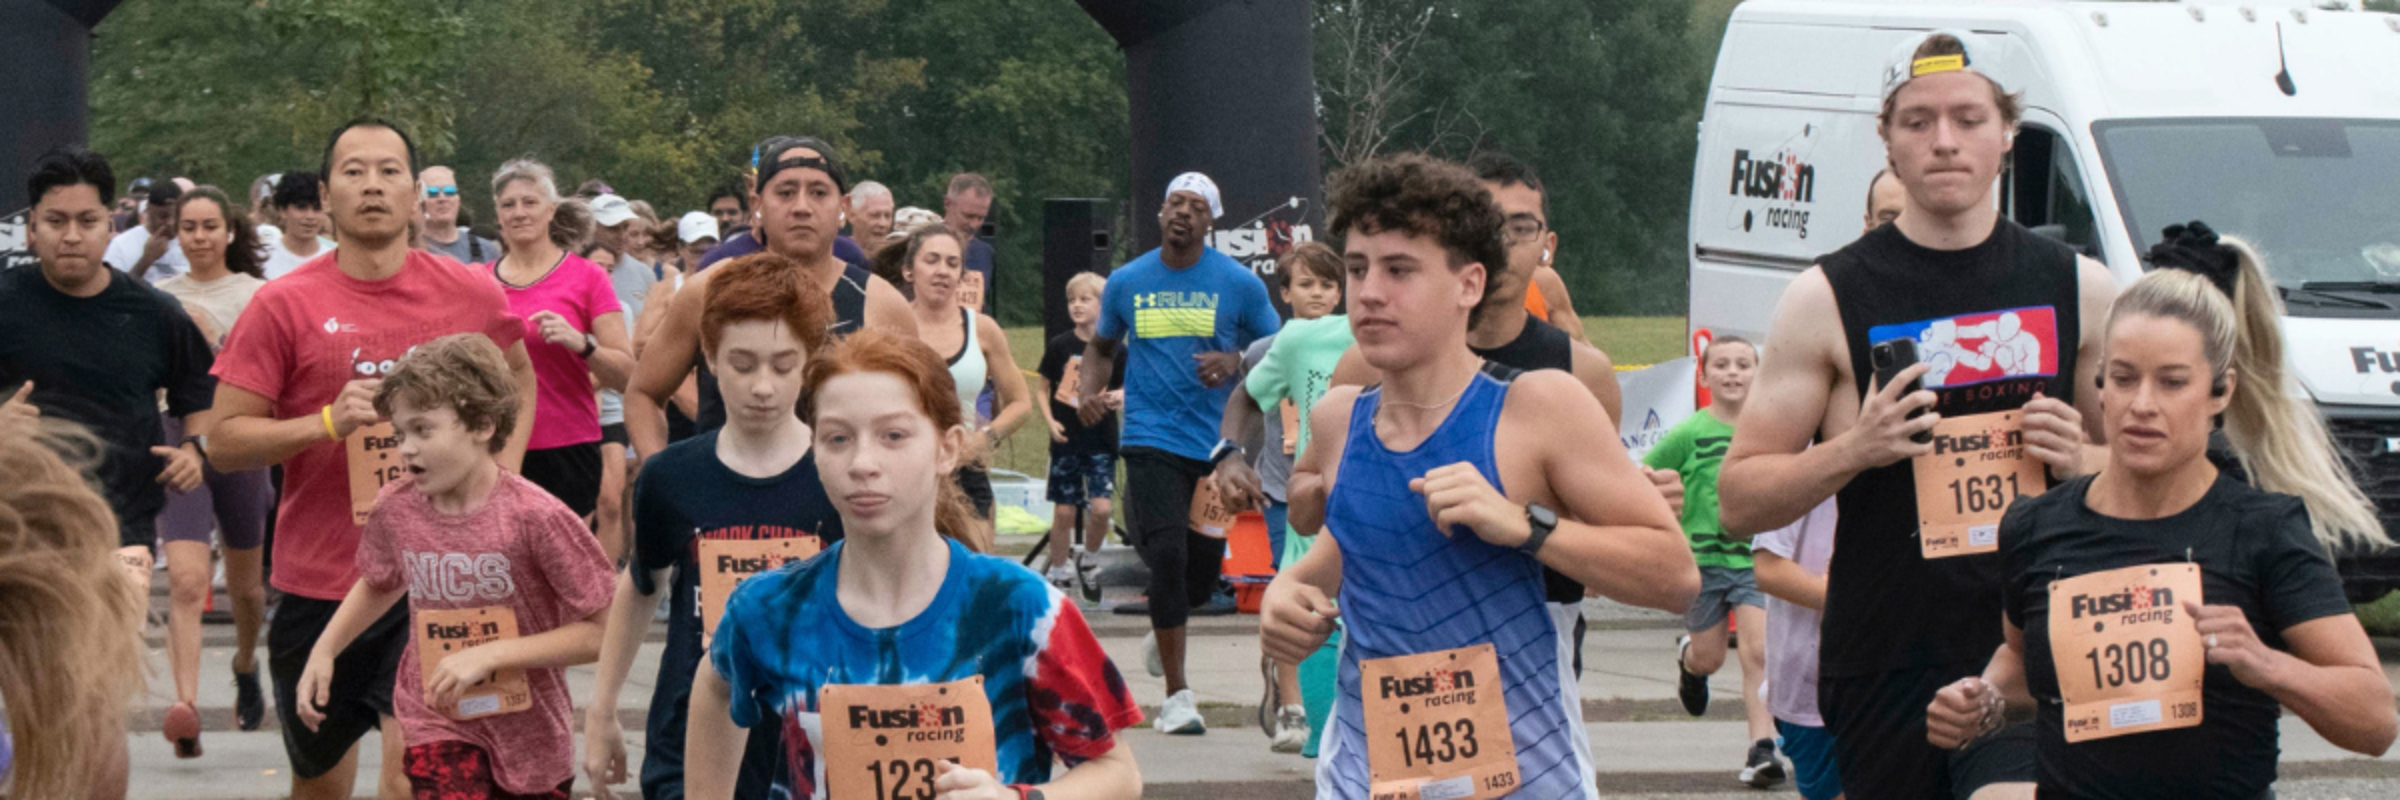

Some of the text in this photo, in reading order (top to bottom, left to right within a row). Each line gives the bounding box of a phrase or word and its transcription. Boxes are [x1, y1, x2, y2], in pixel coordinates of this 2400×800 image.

[1731, 148, 1815, 203] Fusion
[1766, 207, 1810, 239] racing
[1157, 291, 1219, 309] RUN
[1934, 430, 2023, 455] Fusion
[1980, 447, 2024, 462] racing
[1948, 471, 2019, 515] 1631
[402, 549, 515, 602] NCS
[2072, 586, 2174, 619] Fusion
[426, 620, 499, 639] Fusion
[2121, 608, 2174, 626] racing
[2086, 637, 2171, 690] 1308
[1380, 669, 1475, 699] Fusion
[1425, 689, 1476, 708] racing
[2171, 701, 2197, 719] 1308
[848, 703, 965, 729] Fusion
[907, 727, 965, 743] racing
[1395, 717, 1479, 768] 1433
[866, 757, 961, 800] 123
[1483, 770, 1515, 791] 1433
